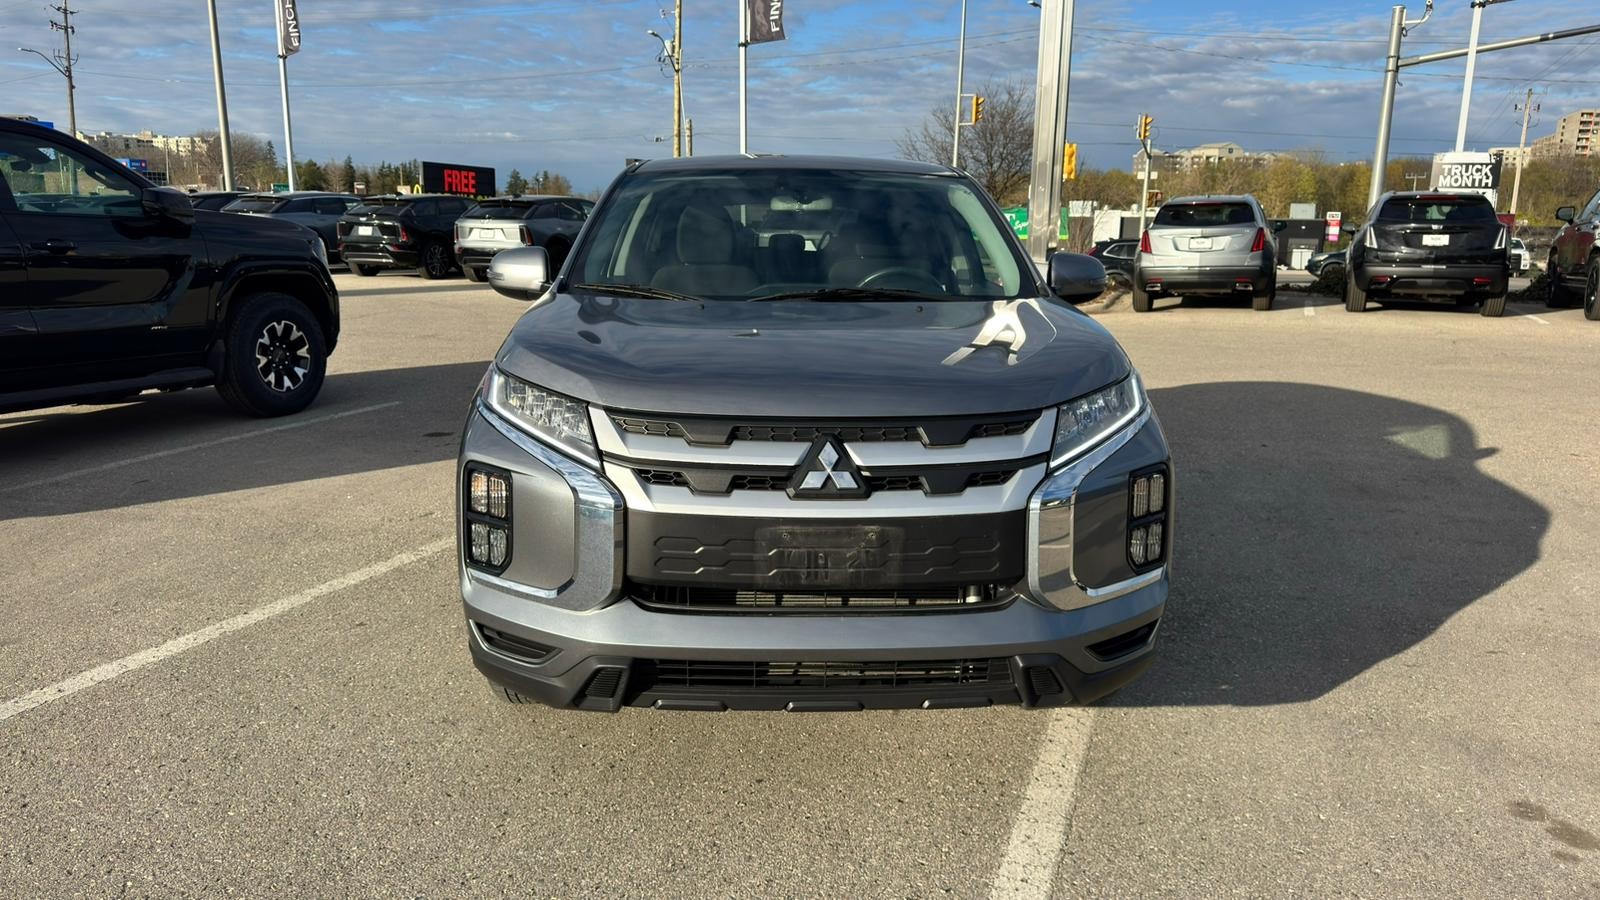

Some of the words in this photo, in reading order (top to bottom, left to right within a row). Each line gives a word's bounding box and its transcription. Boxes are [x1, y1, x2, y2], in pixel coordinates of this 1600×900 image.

[770, 0, 781, 32] FIN
[1442, 164, 1493, 177] TRUCK
[444, 169, 476, 193] FREE
[1438, 175, 1493, 187] MONTH
